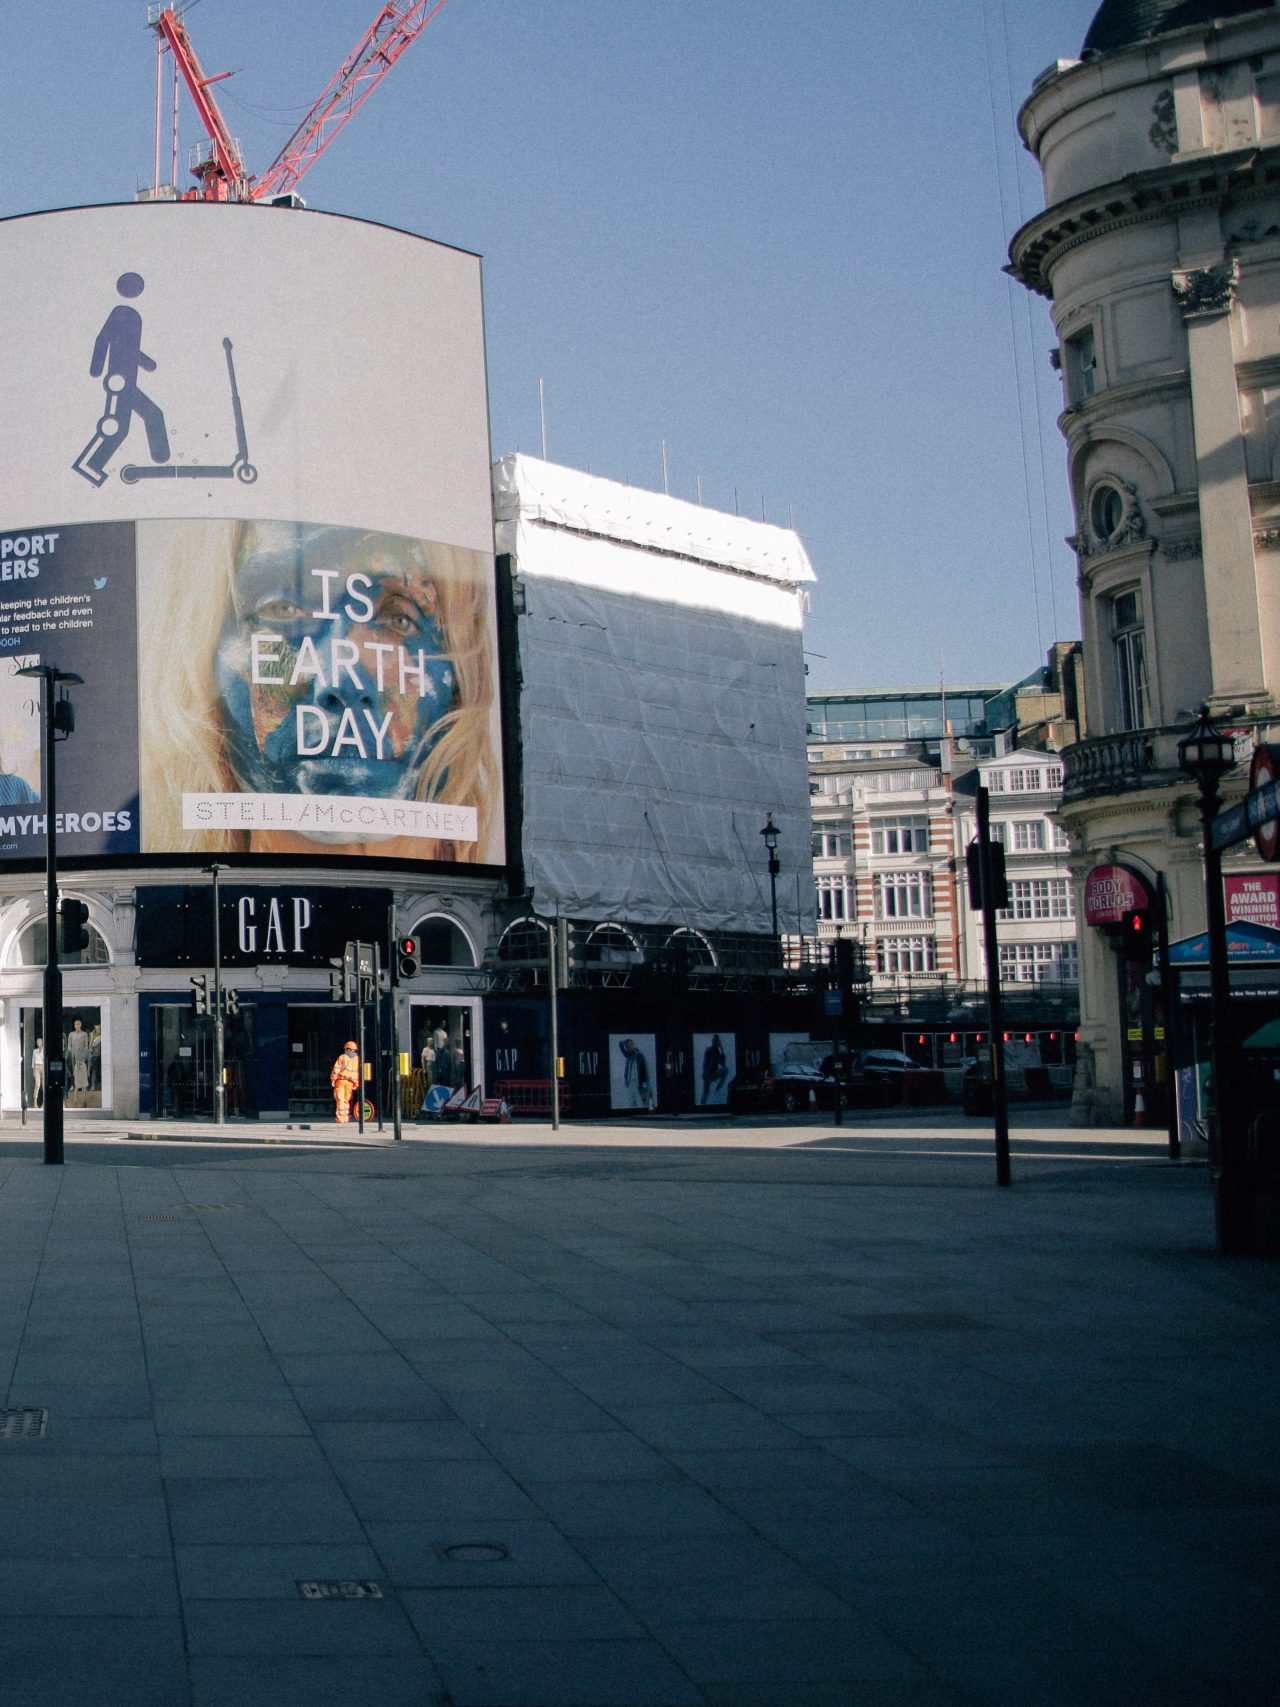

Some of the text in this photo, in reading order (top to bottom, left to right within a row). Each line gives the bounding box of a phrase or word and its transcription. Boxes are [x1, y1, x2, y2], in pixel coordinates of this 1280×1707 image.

[0, 599, 32, 611] keeping
[33, 596, 48, 606] the
[311, 569, 374, 623] IS
[13, 608, 52, 620] feedback
[53, 606, 70, 617] and
[71, 607, 93, 616] even
[1, 627, 10, 635] to
[11, 623, 30, 634] read
[31, 623, 41, 632] to
[42, 620, 57, 630] the
[58, 619, 93, 629] children
[251, 634, 425, 698] EARTH
[296, 704, 393, 760] DAY
[1091, 876, 1122, 897] BODY
[1242, 882, 1262, 891] THE
[1088, 891, 1134, 911] WORLDS
[1230, 892, 1276, 905] AWARD
[1230, 904, 1277, 914] WINNING
[238, 896, 311, 953] GAP
[495, 1049, 518, 1072] GAP
[578, 1052, 598, 1075] GAP
